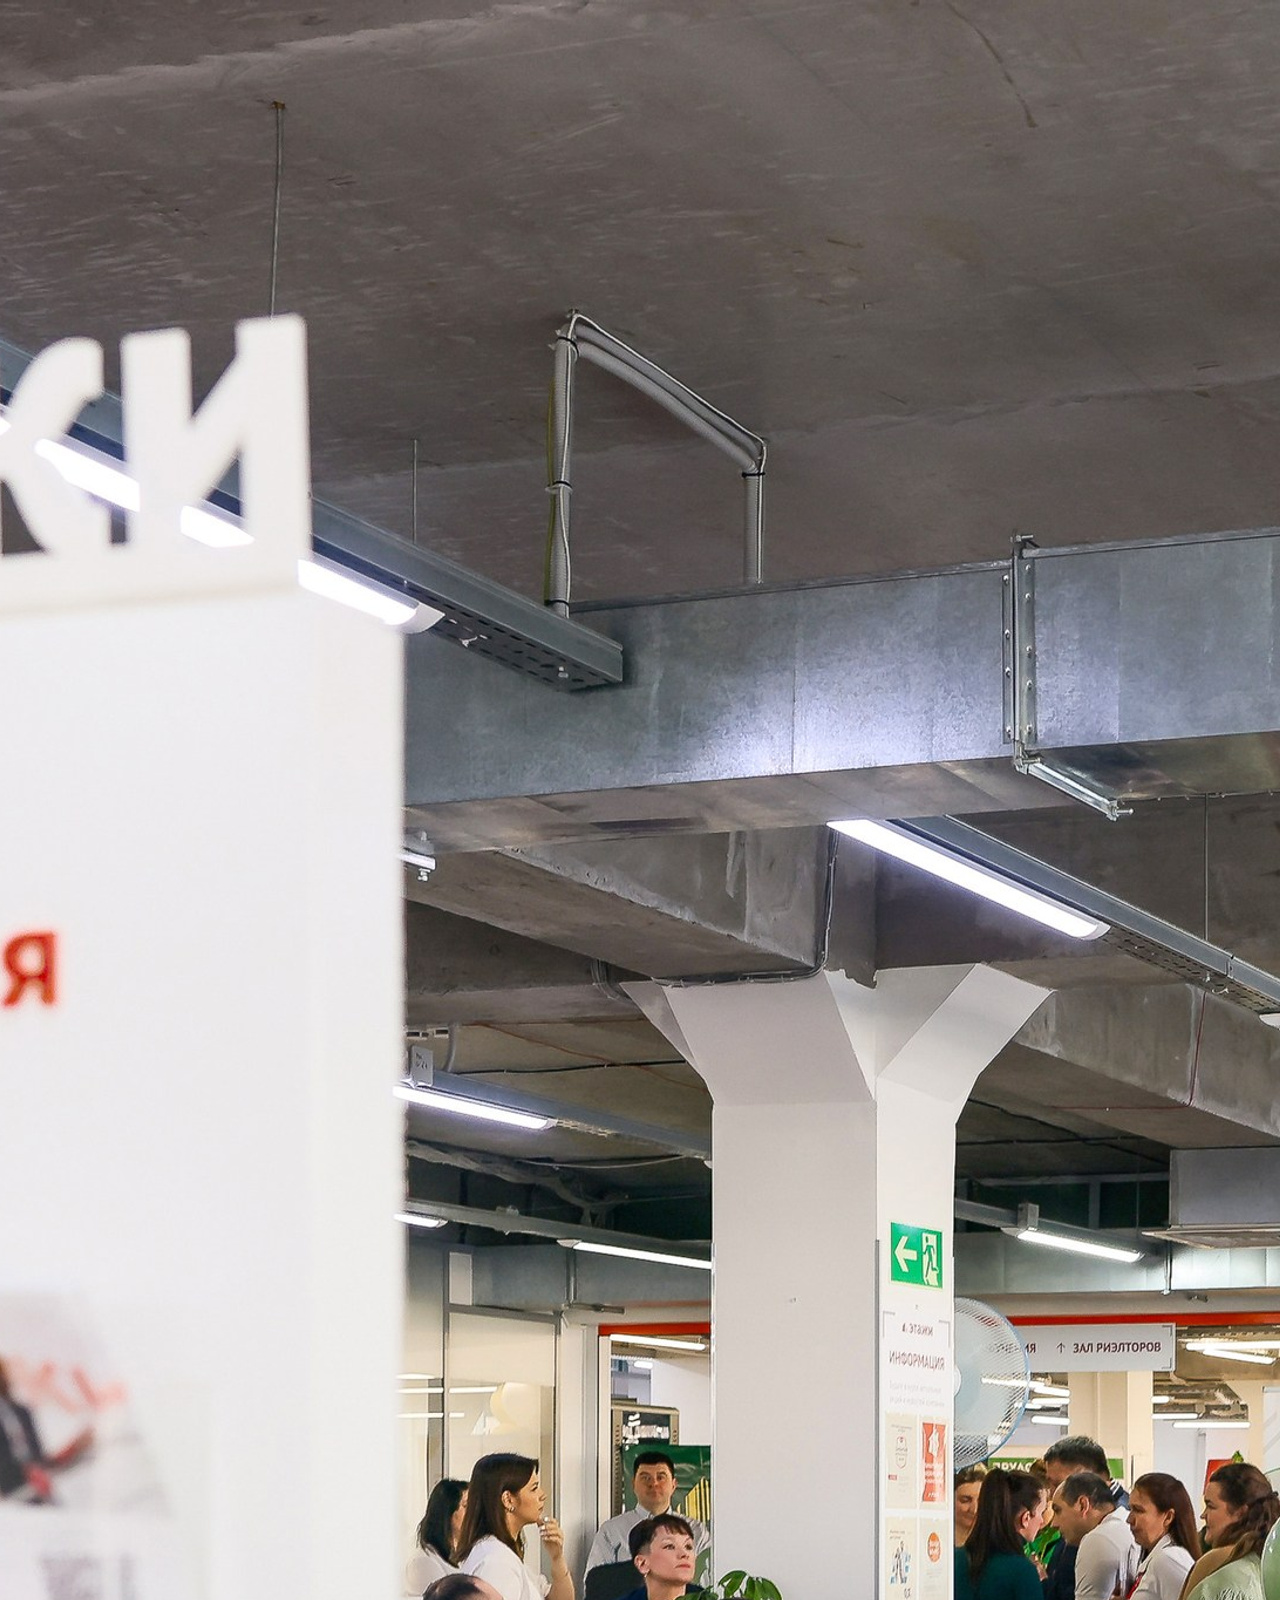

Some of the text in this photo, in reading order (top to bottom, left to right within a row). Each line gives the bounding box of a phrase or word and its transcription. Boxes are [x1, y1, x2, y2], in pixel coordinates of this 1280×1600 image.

[1072, 1341, 1162, 1354] ЗАЛ РИЭЛТОРОВ
[888, 1350, 946, 1371] ИНФОРМАЦИЯ
